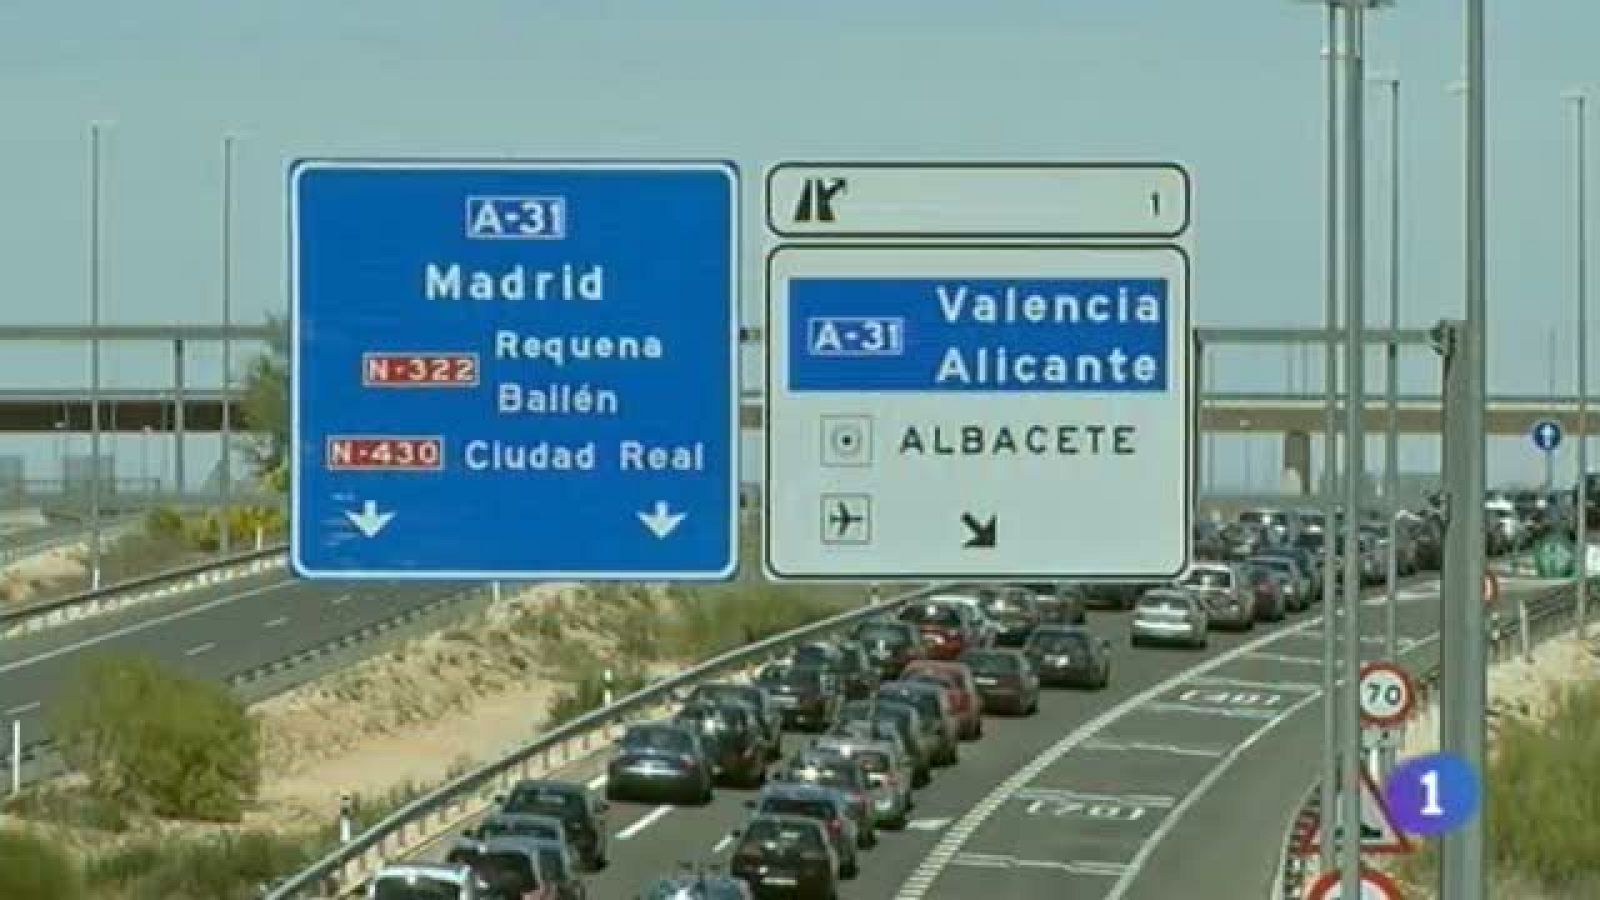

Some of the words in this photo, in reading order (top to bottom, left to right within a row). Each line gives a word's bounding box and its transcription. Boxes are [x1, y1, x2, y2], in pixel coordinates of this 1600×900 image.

[474, 203, 562, 234] A-31
[1150, 193, 1161, 216] 1
[425, 263, 604, 301] Madrid
[935, 286, 1161, 323] Valencia
[495, 330, 663, 364] Requena
[813, 322, 900, 351] A-31
[367, 357, 476, 382] N-322
[935, 347, 1158, 384] Alicante
[498, 384, 618, 414] Bailén
[329, 441, 439, 465] N-430
[464, 440, 596, 471] Ciudad
[619, 440, 705, 471] Real
[898, 425, 1138, 456] ALBACETE
[1366, 684, 1400, 706] 70
